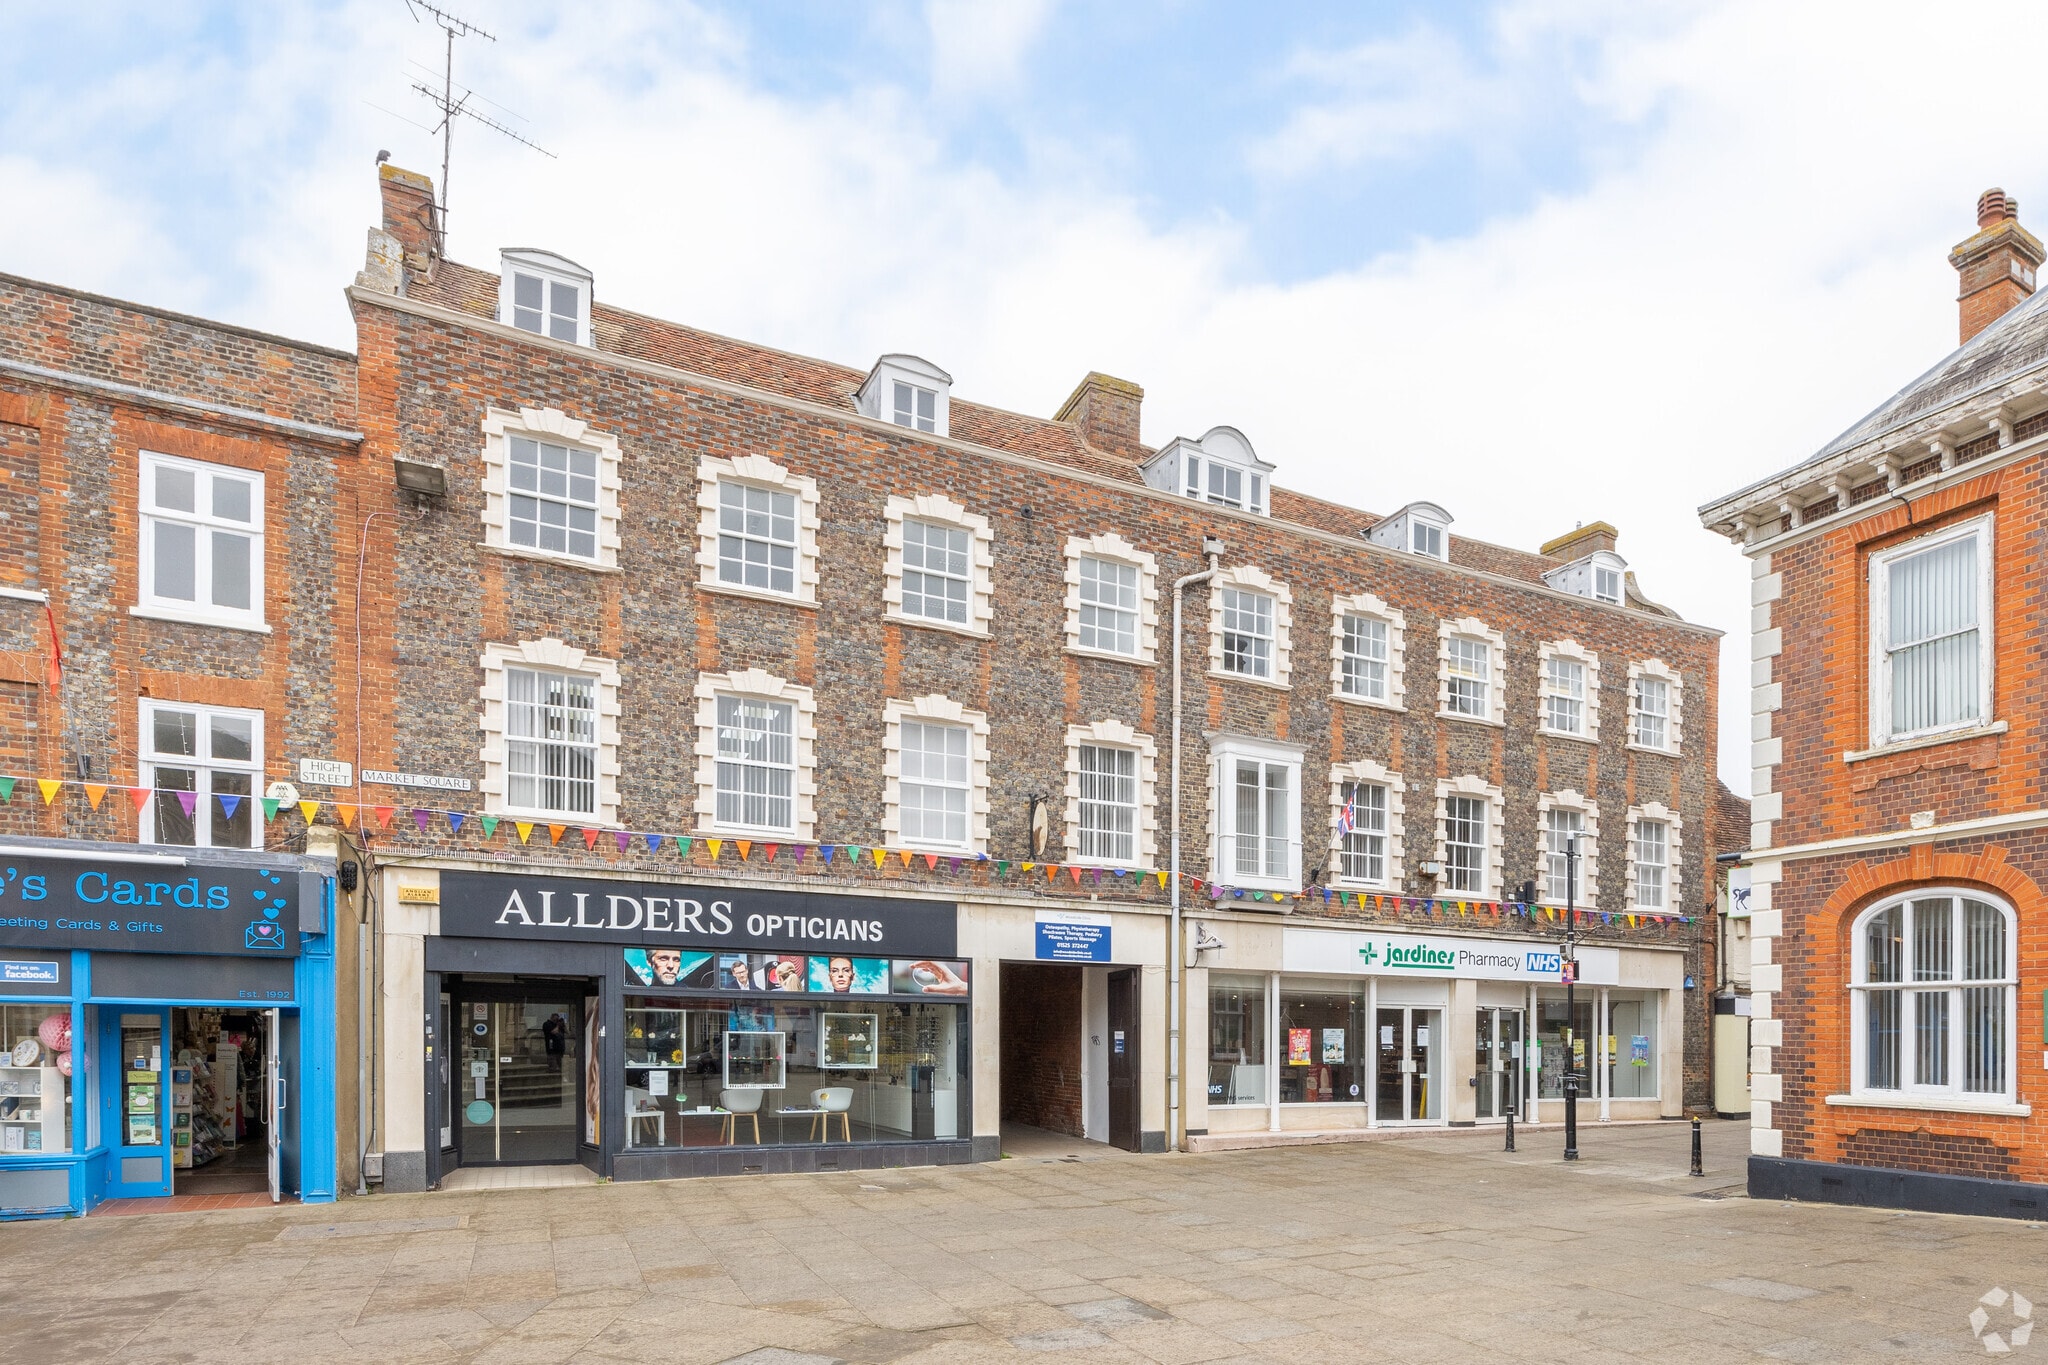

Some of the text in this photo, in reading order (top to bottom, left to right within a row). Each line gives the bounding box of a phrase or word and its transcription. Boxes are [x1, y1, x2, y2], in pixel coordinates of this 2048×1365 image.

[311, 761, 341, 772] HIGH
[302, 771, 349, 785] STREET
[364, 770, 469, 789] MARKET SQUARE
[0, 867, 230, 910] 's Cards
[495, 888, 884, 943] ALLDERS OPTICIANS
[55, 918, 102, 930] Cards
[108, 920, 120, 931] &
[126, 921, 163, 933] Gifts
[1383, 942, 1560, 971] jardines Pharmacy NHS
[239, 990, 290, 999] Est. 1992
